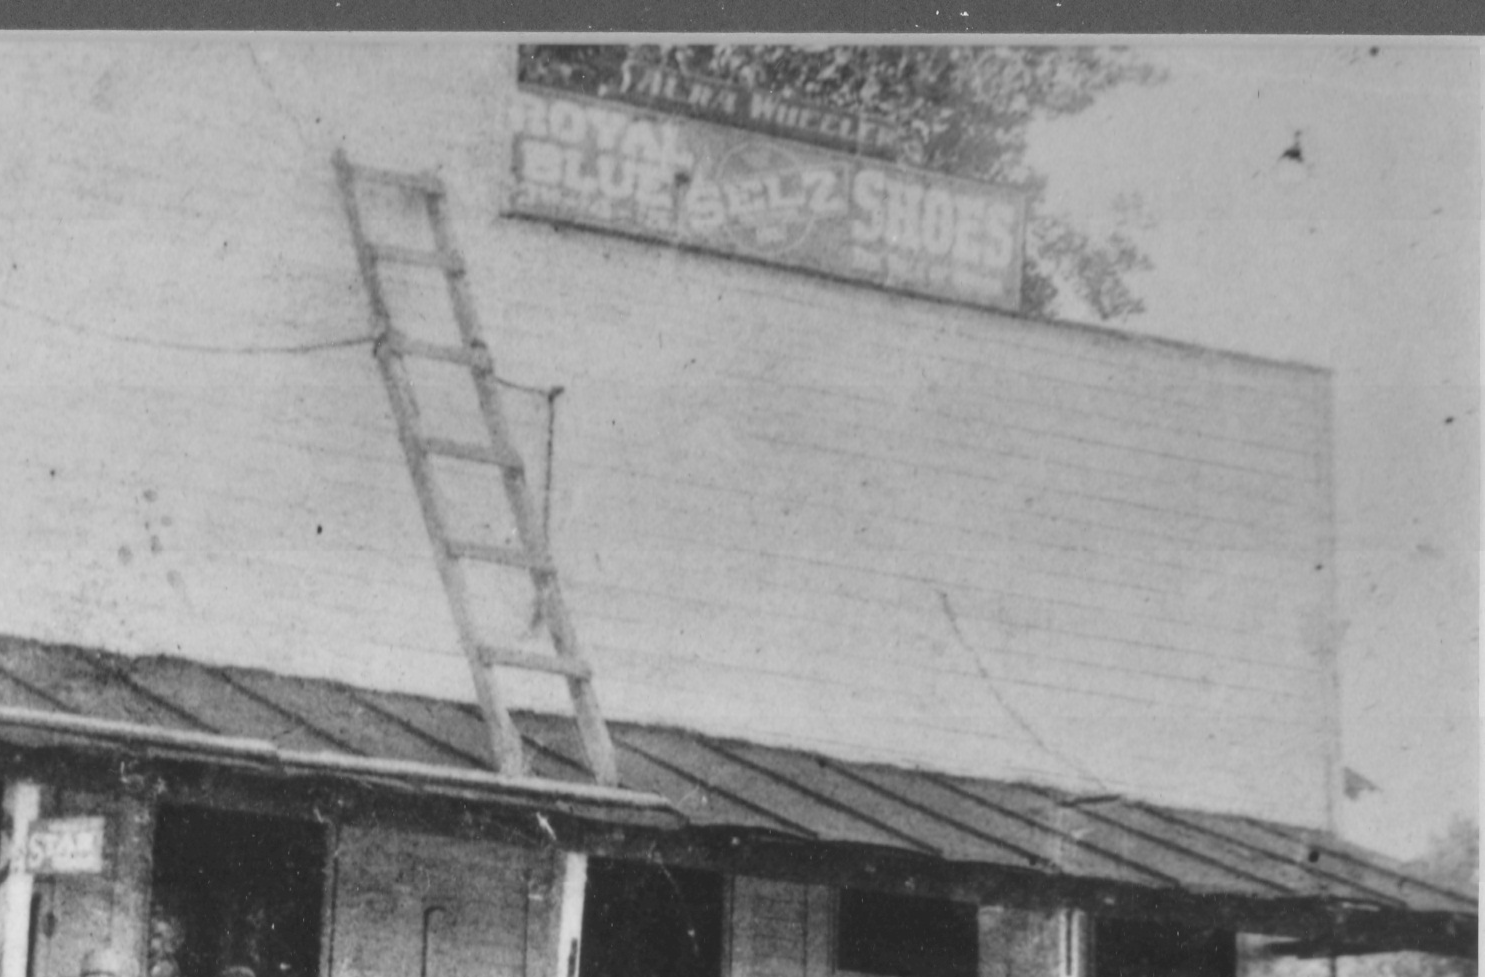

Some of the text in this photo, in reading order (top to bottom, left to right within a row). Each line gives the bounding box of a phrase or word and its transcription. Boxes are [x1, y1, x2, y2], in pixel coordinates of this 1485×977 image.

[511, 98, 694, 167] ROYAL
[522, 139, 674, 209] BLUE
[852, 168, 1013, 268] SHOES
